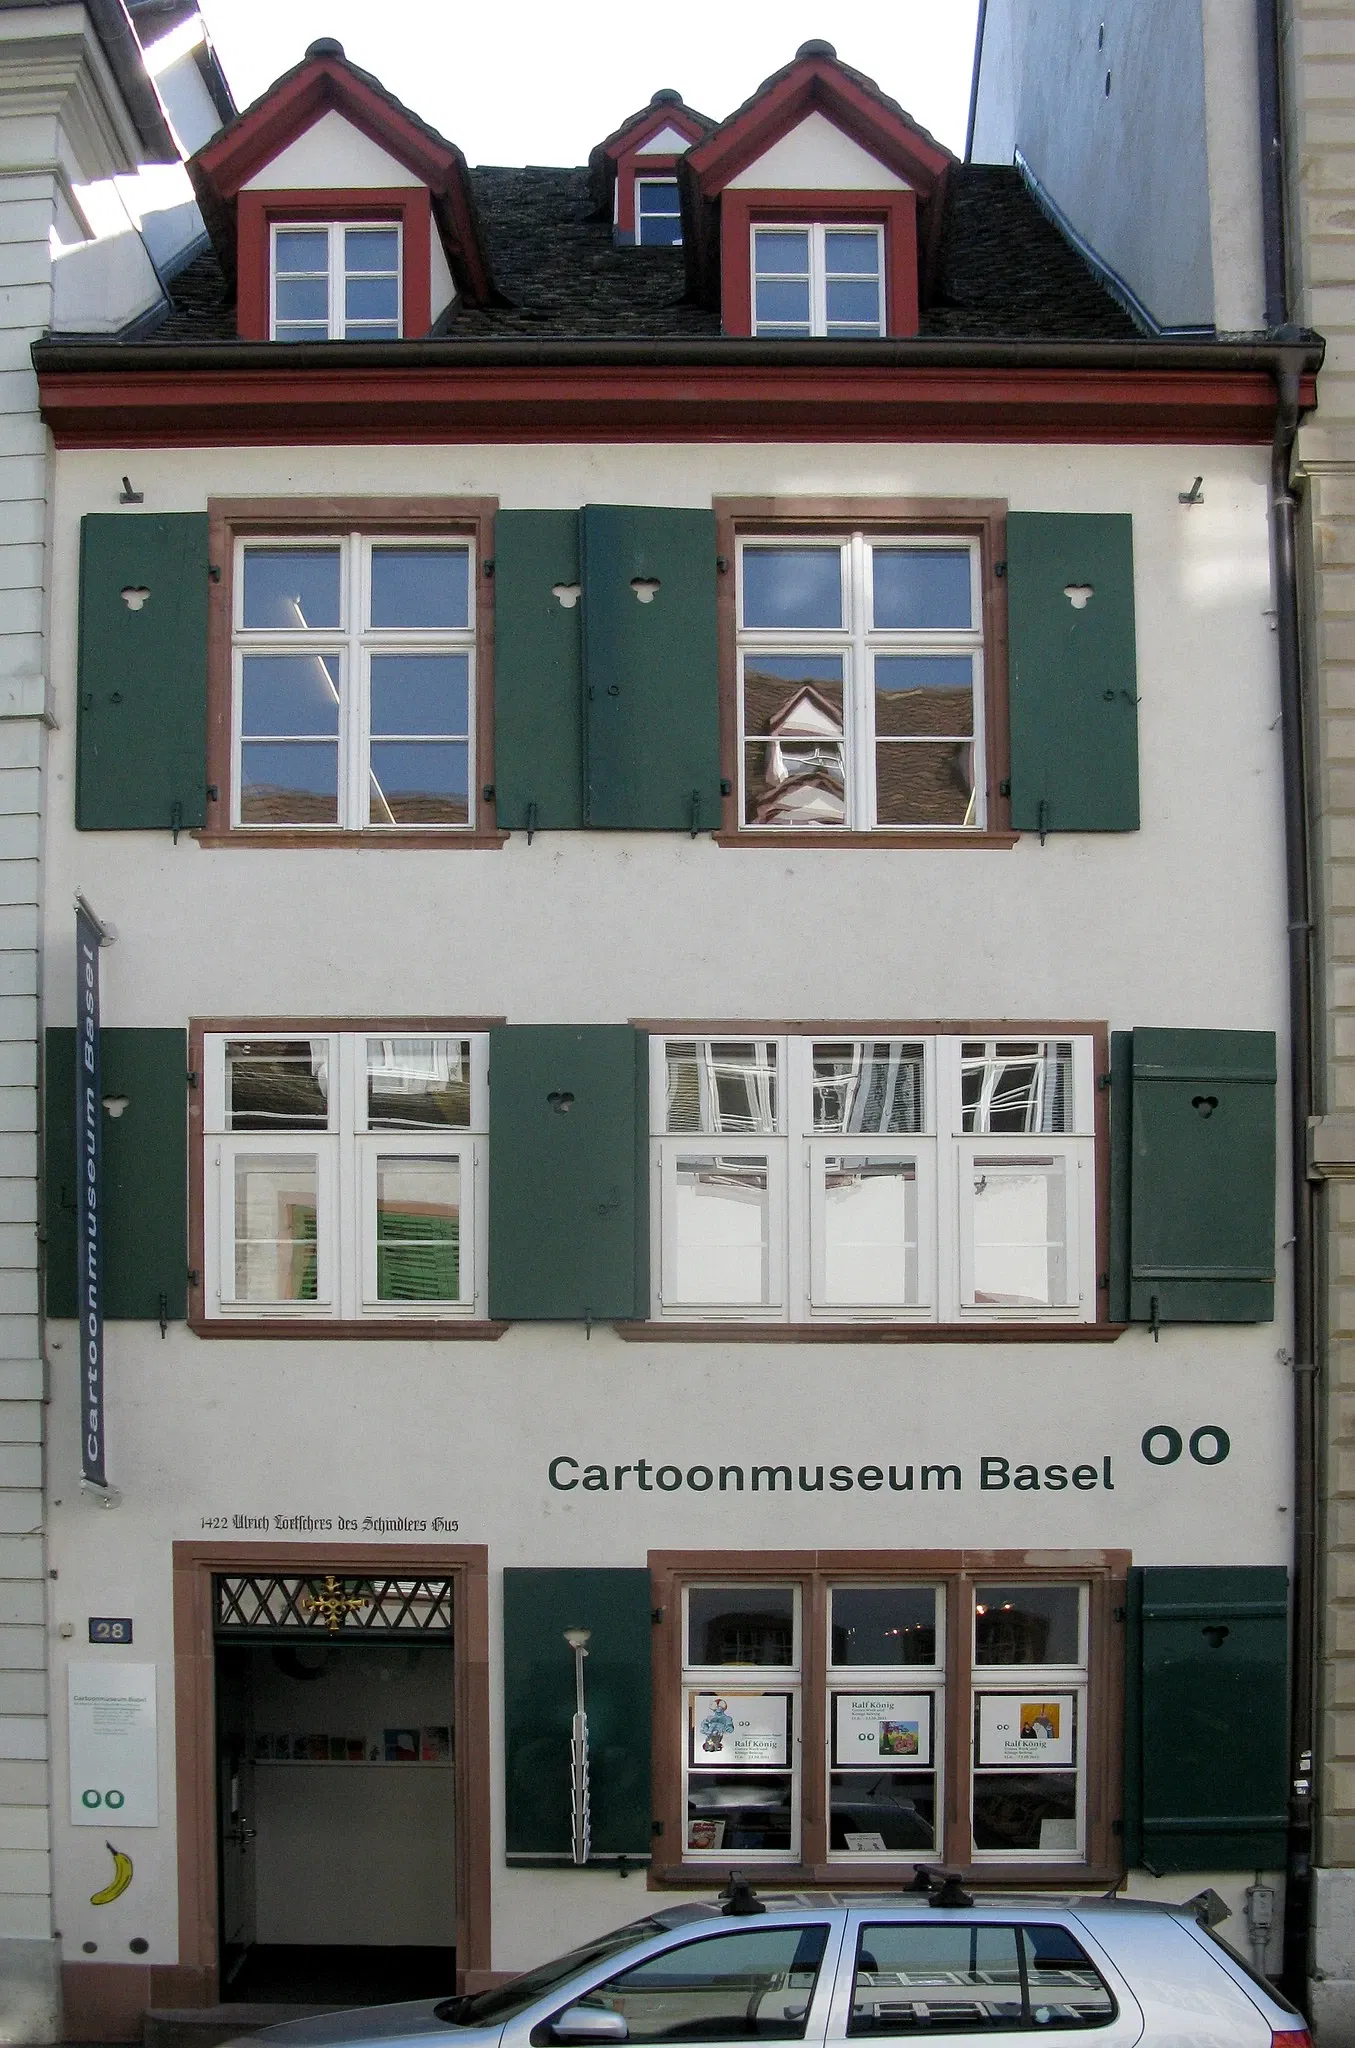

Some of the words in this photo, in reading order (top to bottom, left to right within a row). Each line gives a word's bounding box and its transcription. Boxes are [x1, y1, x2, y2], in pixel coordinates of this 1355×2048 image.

[83, 943, 95, 1074] Basel
[87, 1086, 99, 1462] Cartoonmuseum
[549, 1456, 962, 1492] Cartoonmuseum
[980, 1455, 1115, 1492] Basel
[200, 1516, 229, 1529] 1422
[231, 1514, 270, 1533] Ulrich
[337, 1515, 359, 1532] des
[360, 1515, 428, 1536] Schindlers
[97, 1623, 124, 1638] 28
[851, 1701, 870, 1709] Ralf
[870, 1701, 895, 1710] König
[734, 1740, 752, 1748] Ralf
[752, 1740, 778, 1749] König
[1004, 1740, 1022, 1748] Ralf
[1022, 1740, 1047, 1749] König
